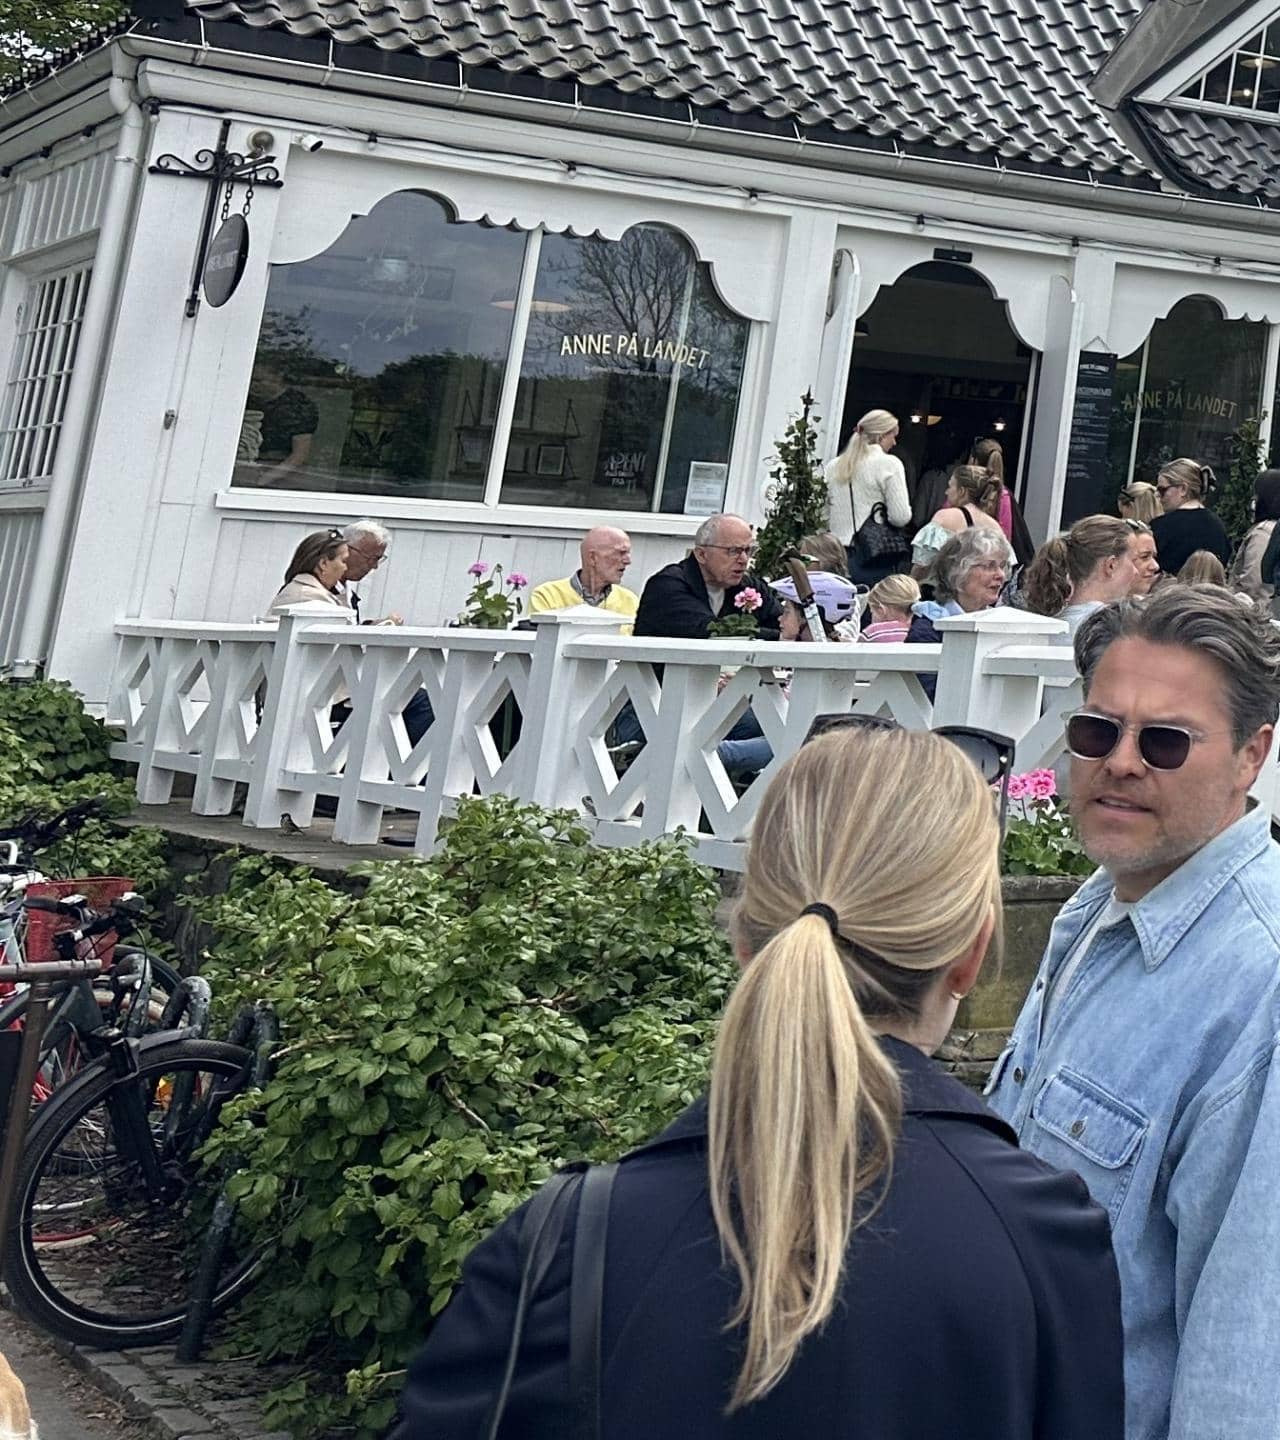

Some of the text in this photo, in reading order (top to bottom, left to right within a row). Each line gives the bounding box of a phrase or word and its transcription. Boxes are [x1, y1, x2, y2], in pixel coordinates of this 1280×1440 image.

[560, 332, 710, 369] ANNE PÅ LANDET
[1123, 391, 1162, 410] ANNE
[1167, 387, 1183, 409] PÅ
[1187, 392, 1237, 419] LANDET
